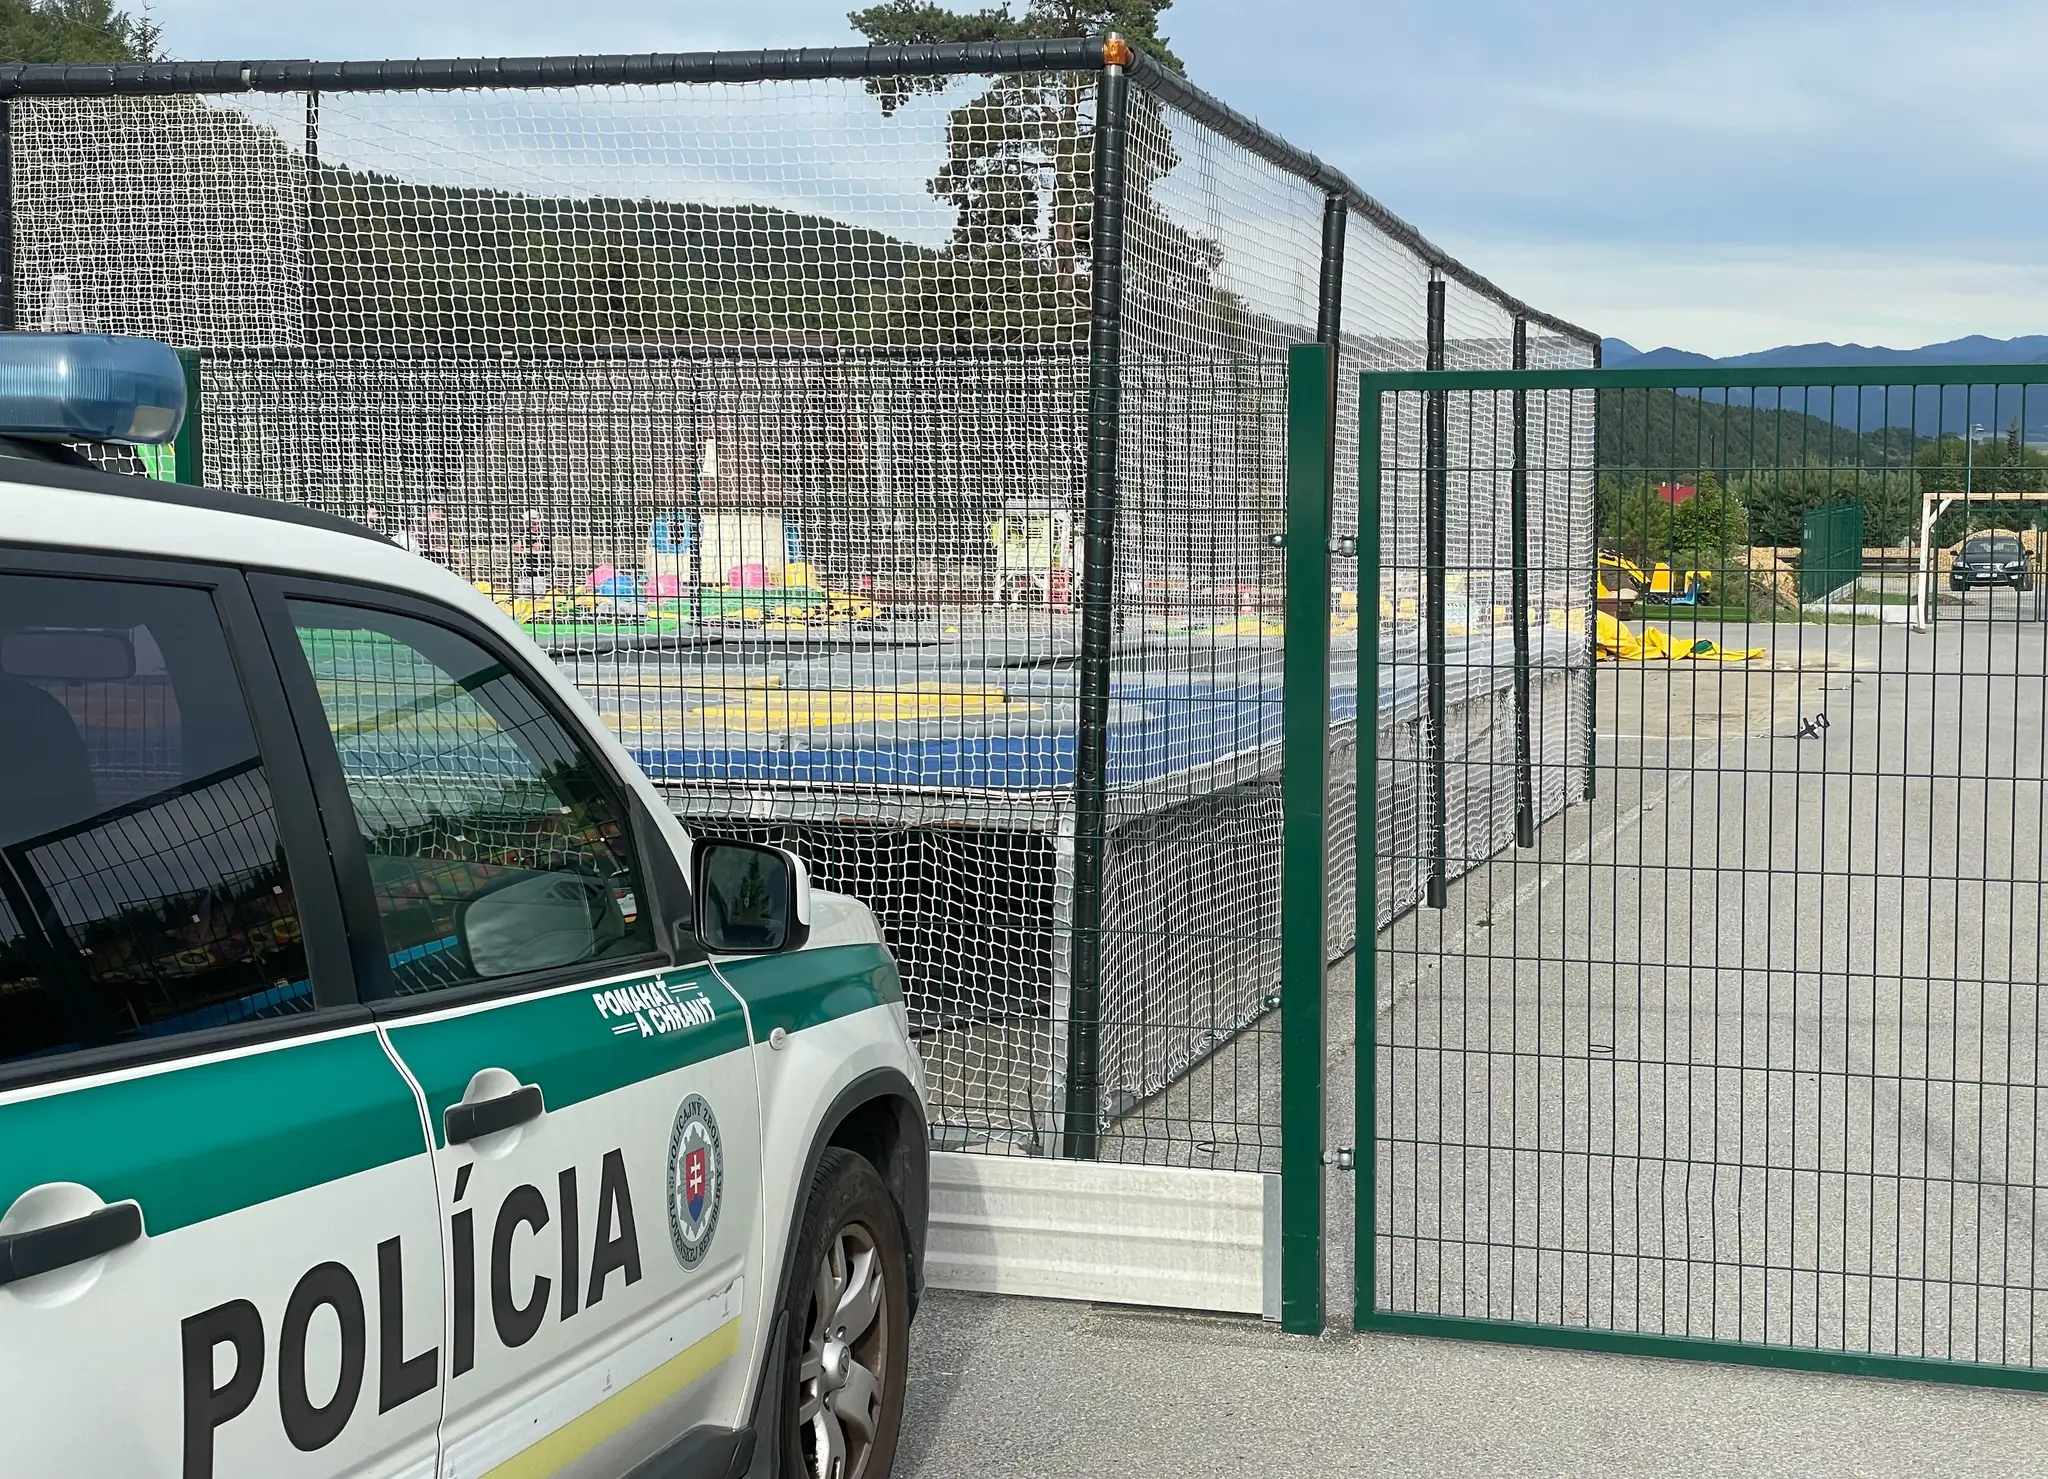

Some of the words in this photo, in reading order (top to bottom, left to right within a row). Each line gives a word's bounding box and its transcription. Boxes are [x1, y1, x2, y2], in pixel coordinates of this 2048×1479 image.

[634, 1011, 654, 1038] A
[669, 1097, 702, 1172] POLICAJNÝ
[703, 1108, 720, 1153] ZBOR
[181, 1148, 642, 1479] POLÍCIA
